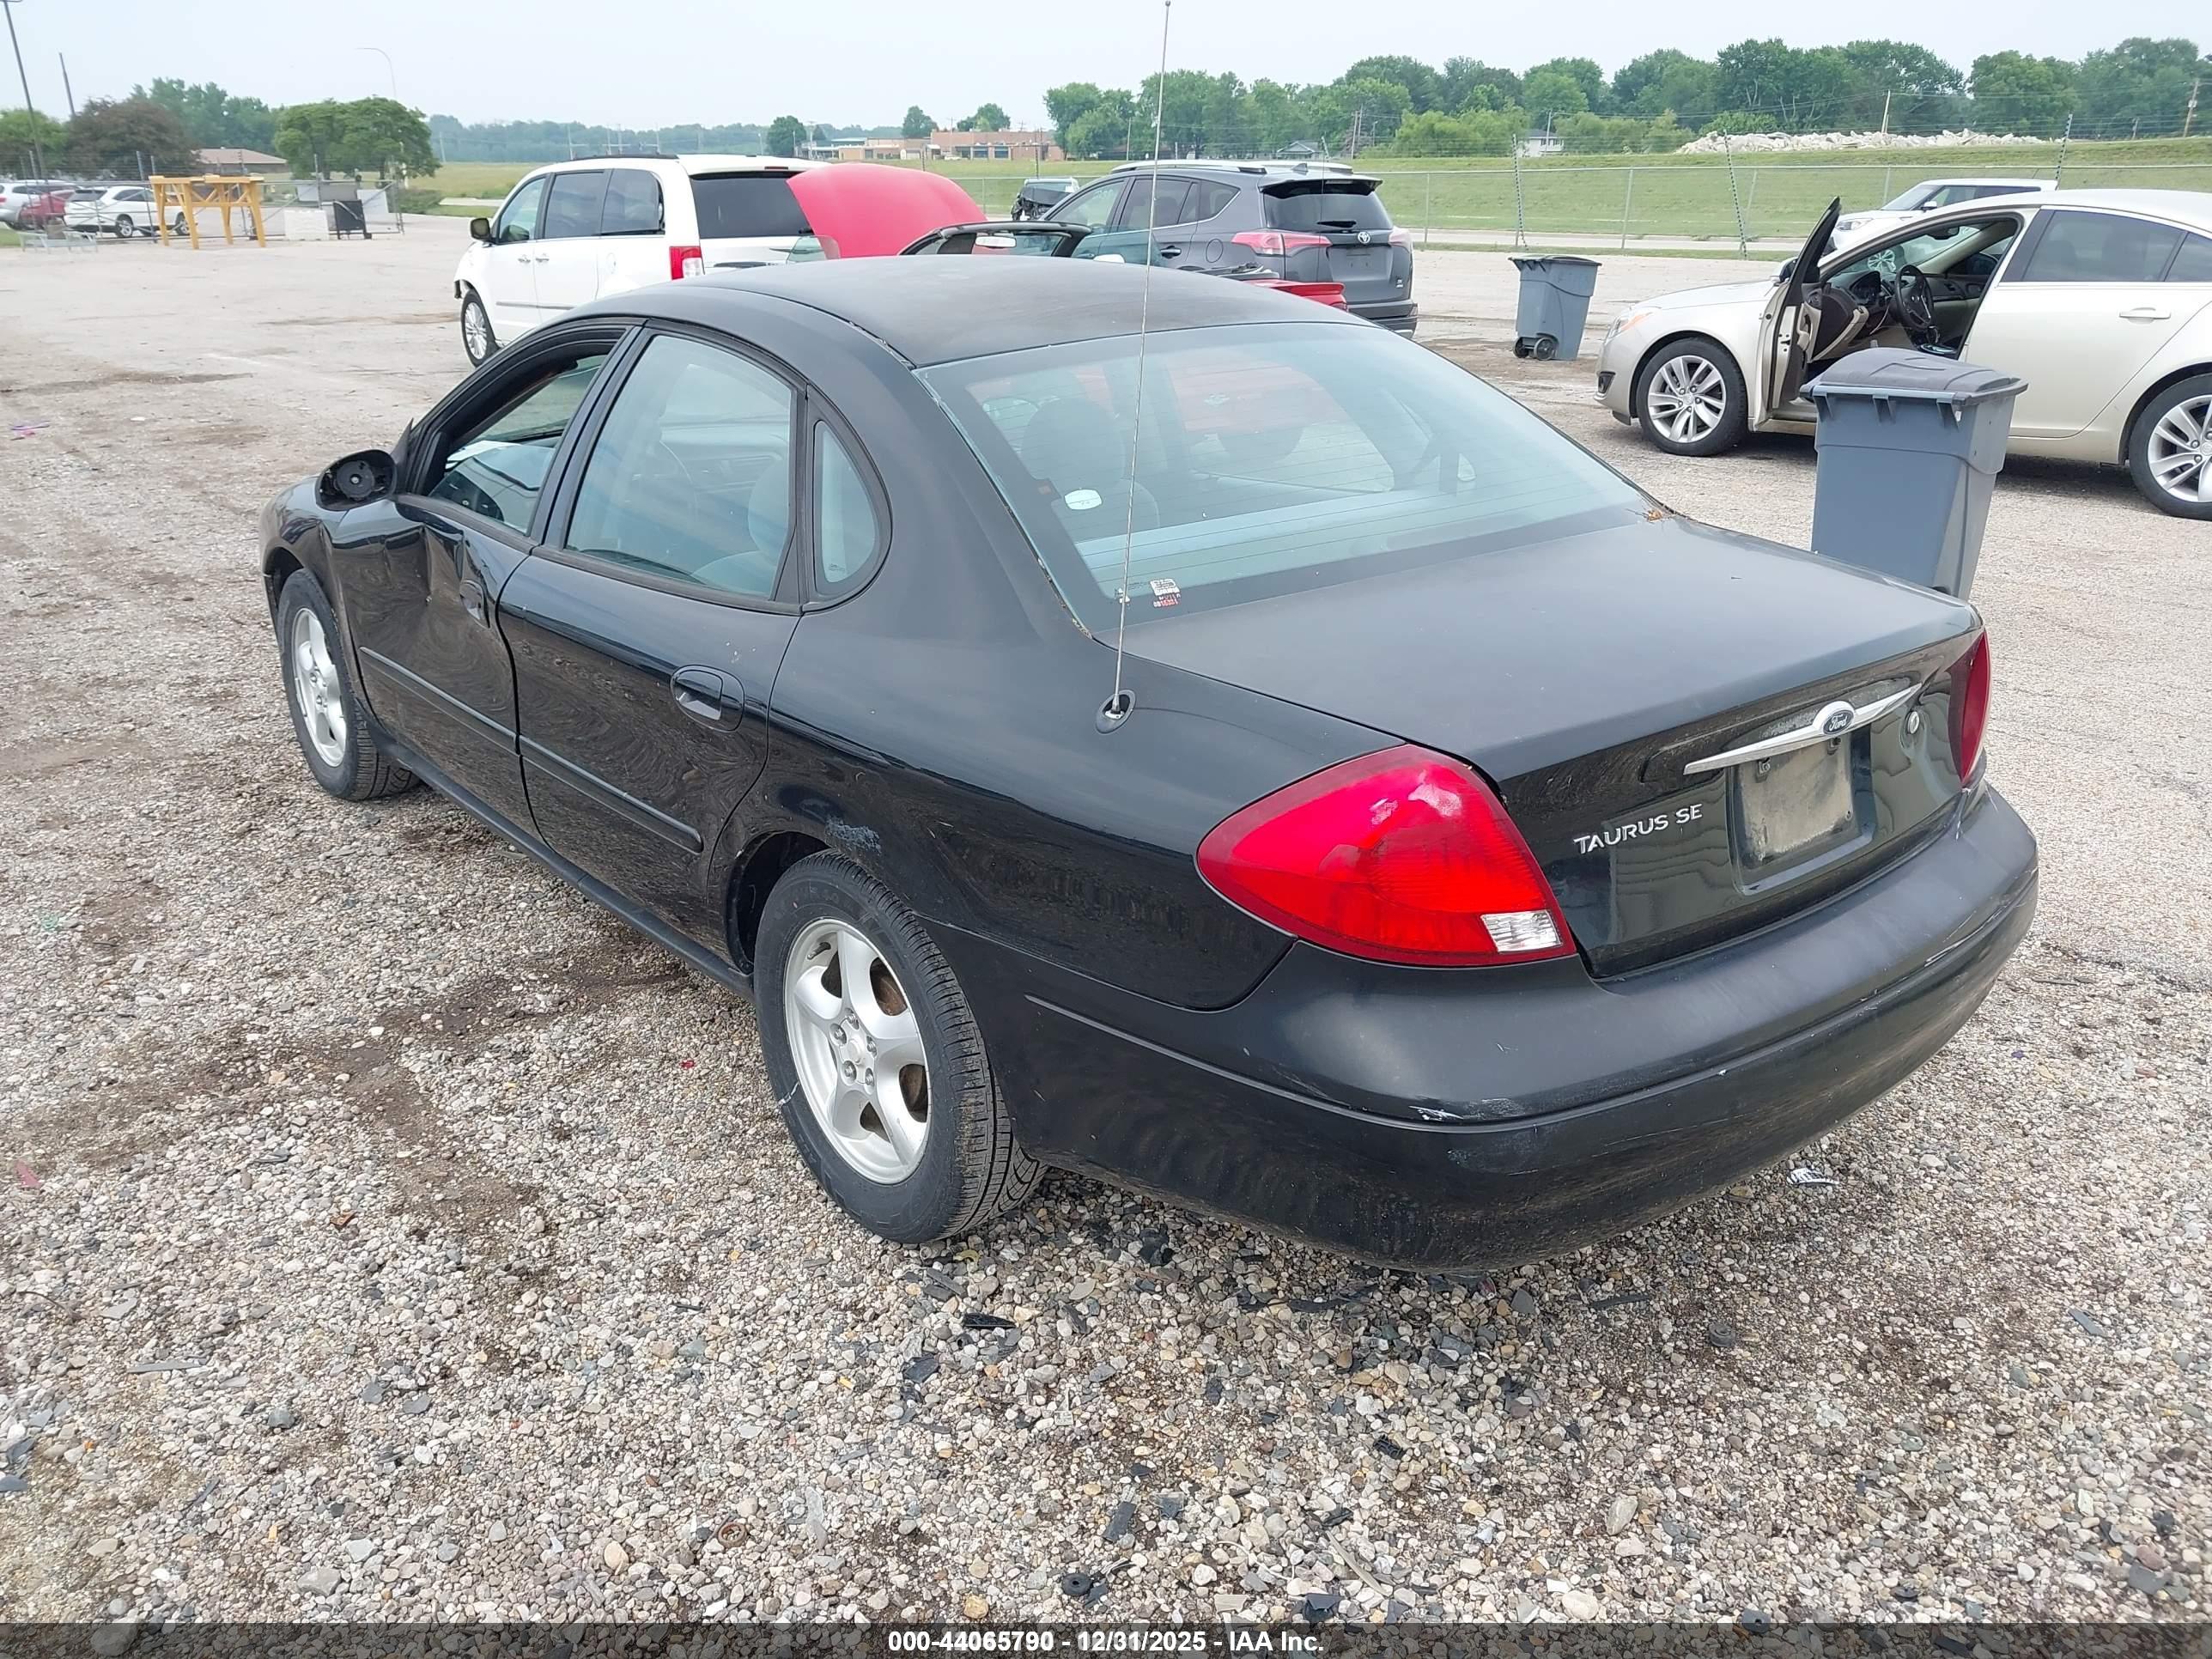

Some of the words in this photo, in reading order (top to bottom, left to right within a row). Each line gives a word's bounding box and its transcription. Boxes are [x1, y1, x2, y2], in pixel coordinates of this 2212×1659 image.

[1829, 714, 1848, 732] Ford
[1573, 814, 1669, 854] TAURUS
[1675, 803, 1703, 823] SE
